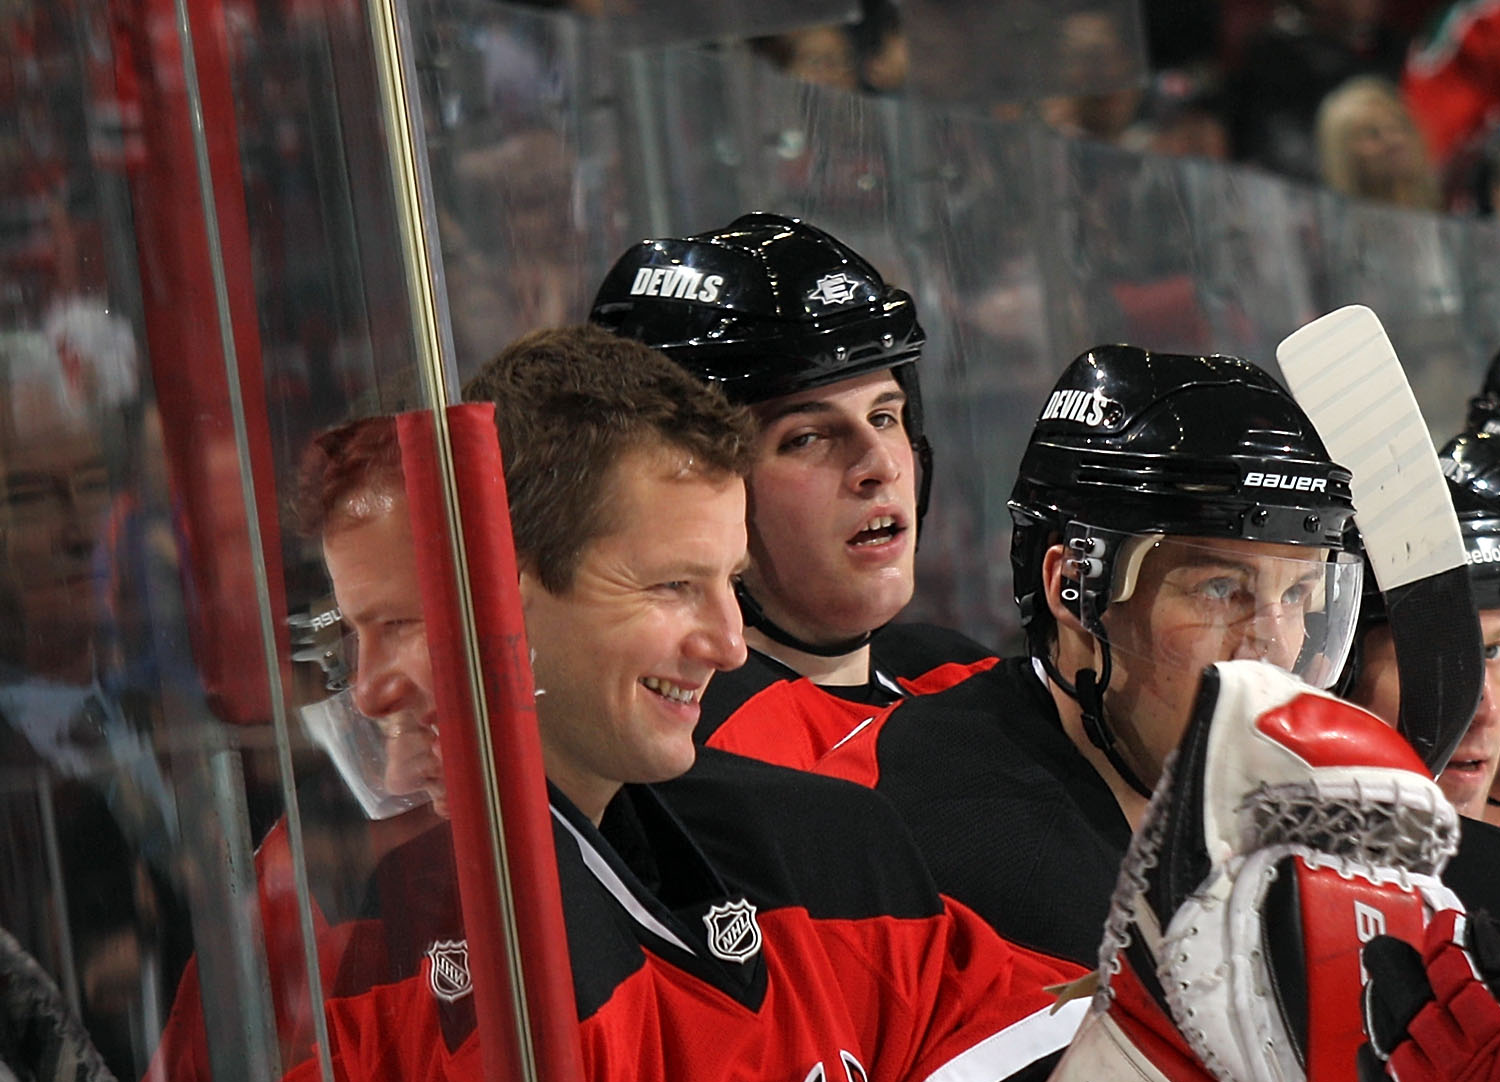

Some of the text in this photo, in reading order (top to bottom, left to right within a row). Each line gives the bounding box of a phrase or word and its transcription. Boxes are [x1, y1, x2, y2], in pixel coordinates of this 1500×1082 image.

[630, 267, 724, 302] DEVILS
[1041, 389, 1108, 426] DEVILS
[1244, 472, 1328, 493] BAUER
[720, 918, 750, 951] NHL
